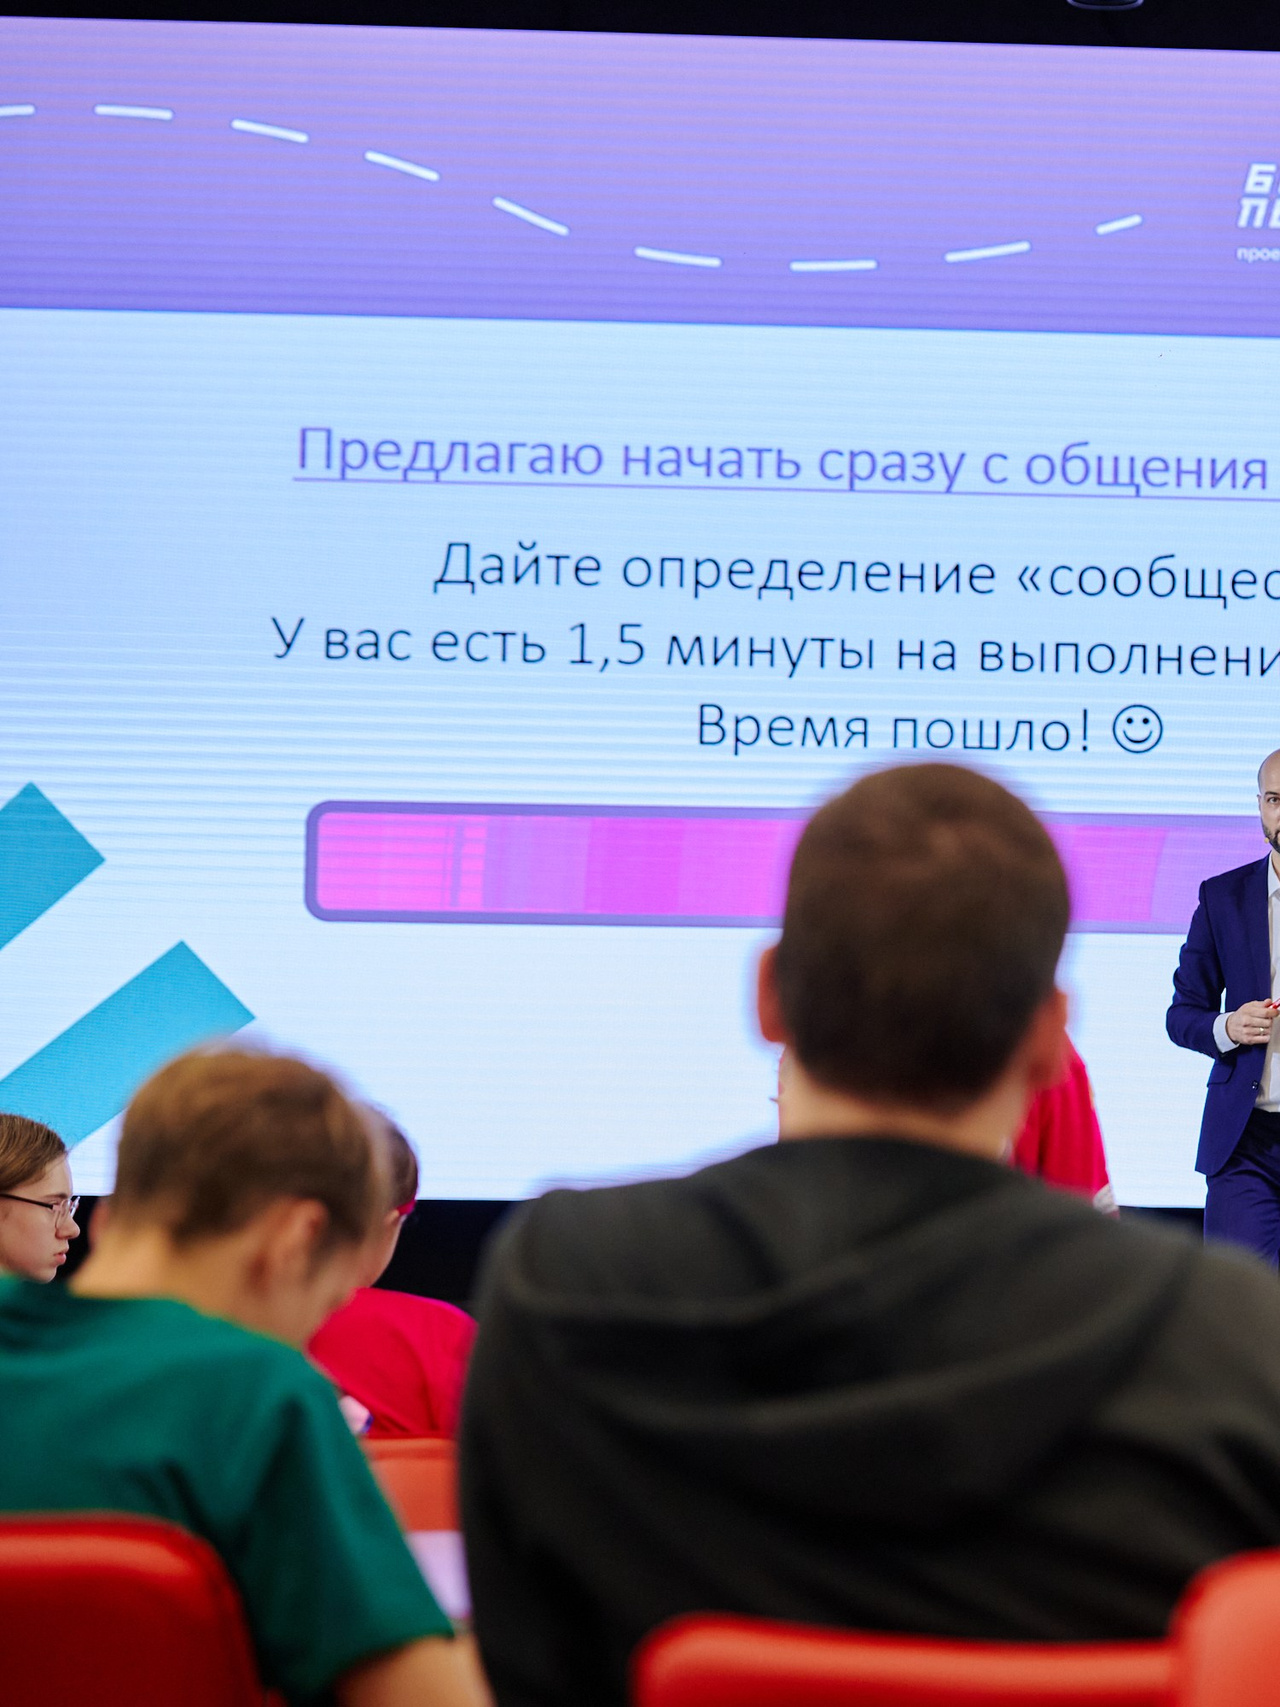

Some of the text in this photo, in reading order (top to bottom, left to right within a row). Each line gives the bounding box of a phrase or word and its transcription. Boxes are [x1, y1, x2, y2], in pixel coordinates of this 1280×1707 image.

[298, 427, 603, 482] Предлагаю
[621, 443, 802, 481] начать
[818, 448, 967, 493] сразу
[982, 452, 1009, 485] с
[1024, 440, 1268, 498] общения
[432, 539, 602, 595] Дайте
[622, 555, 997, 601] определение
[271, 616, 306, 660] У
[324, 628, 412, 662] вас
[431, 629, 547, 665] есть
[568, 621, 645, 674] 1,5
[666, 634, 875, 679] минуты
[898, 639, 957, 672] на
[697, 703, 1089, 757] Время пошло!
